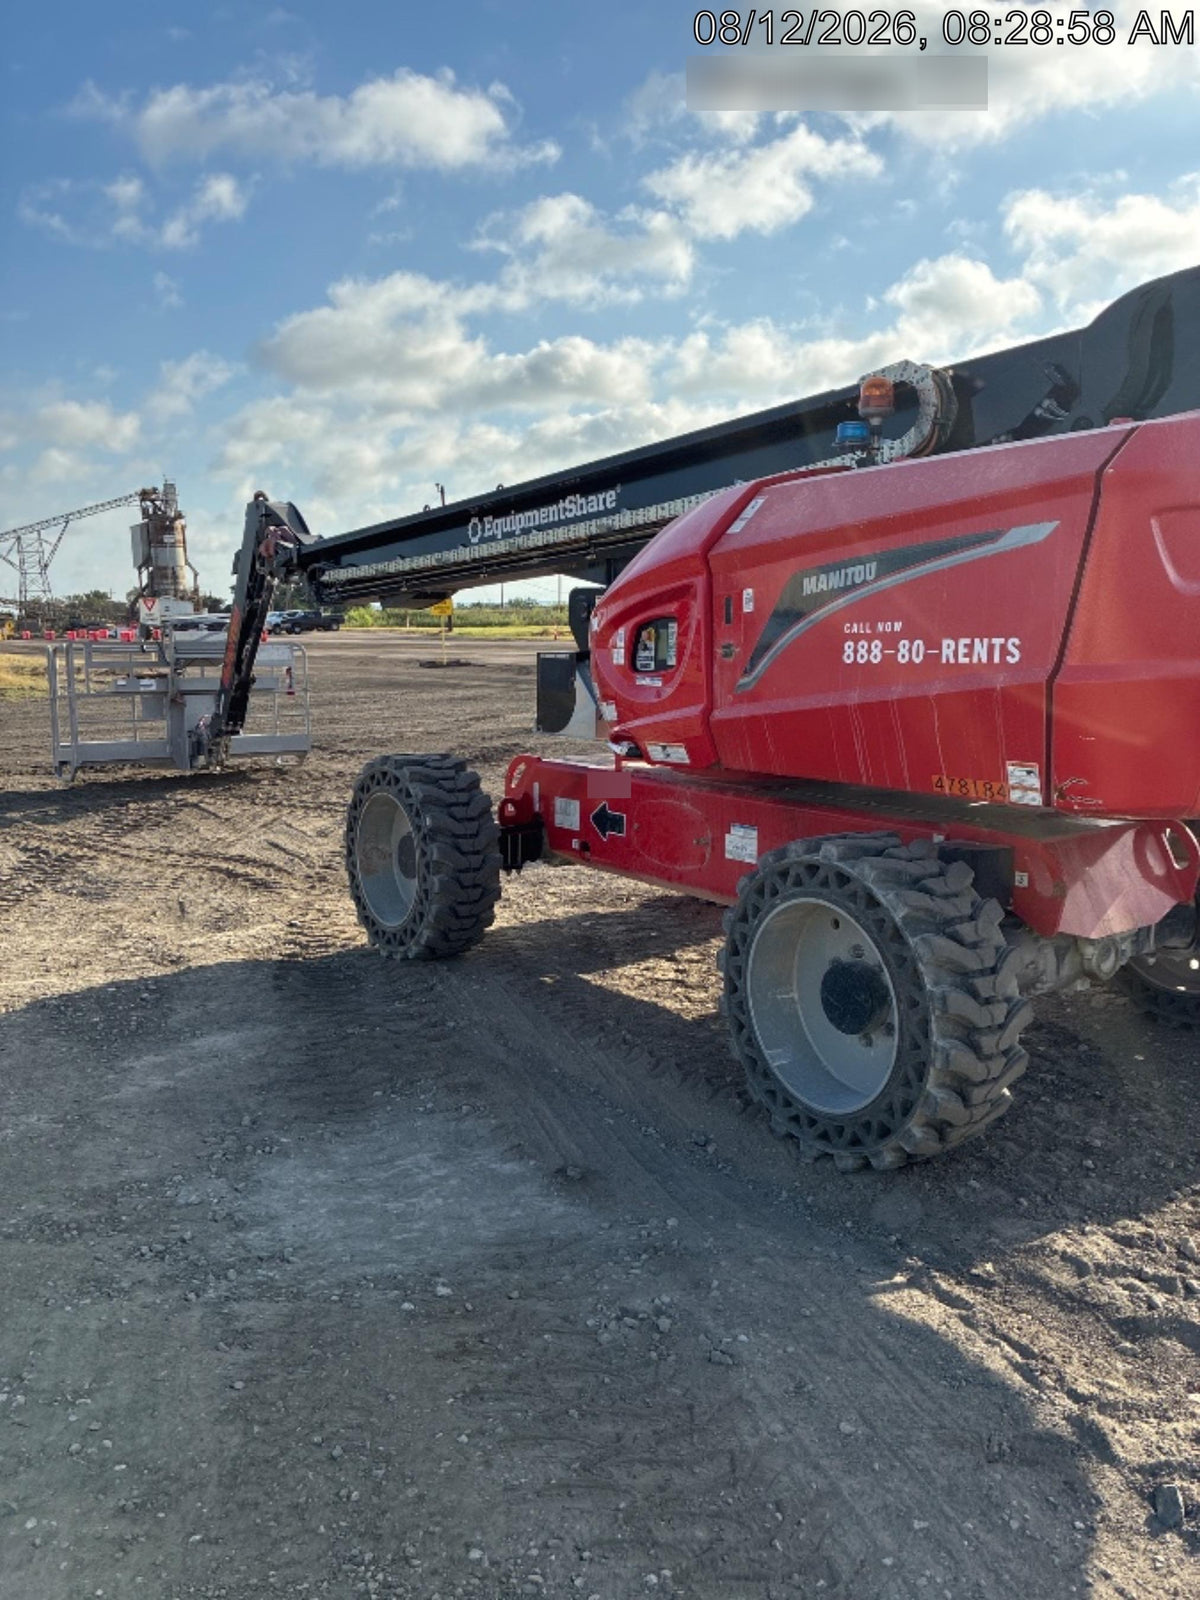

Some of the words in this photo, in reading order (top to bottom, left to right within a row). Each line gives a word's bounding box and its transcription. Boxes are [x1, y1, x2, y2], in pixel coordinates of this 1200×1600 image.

[483, 488, 618, 539] EquipmentShare
[802, 561, 878, 597] MANITOU
[843, 622, 872, 634] CALL
[876, 621, 903, 633] NOW
[842, 637, 1022, 665] 888-80-RENTS
